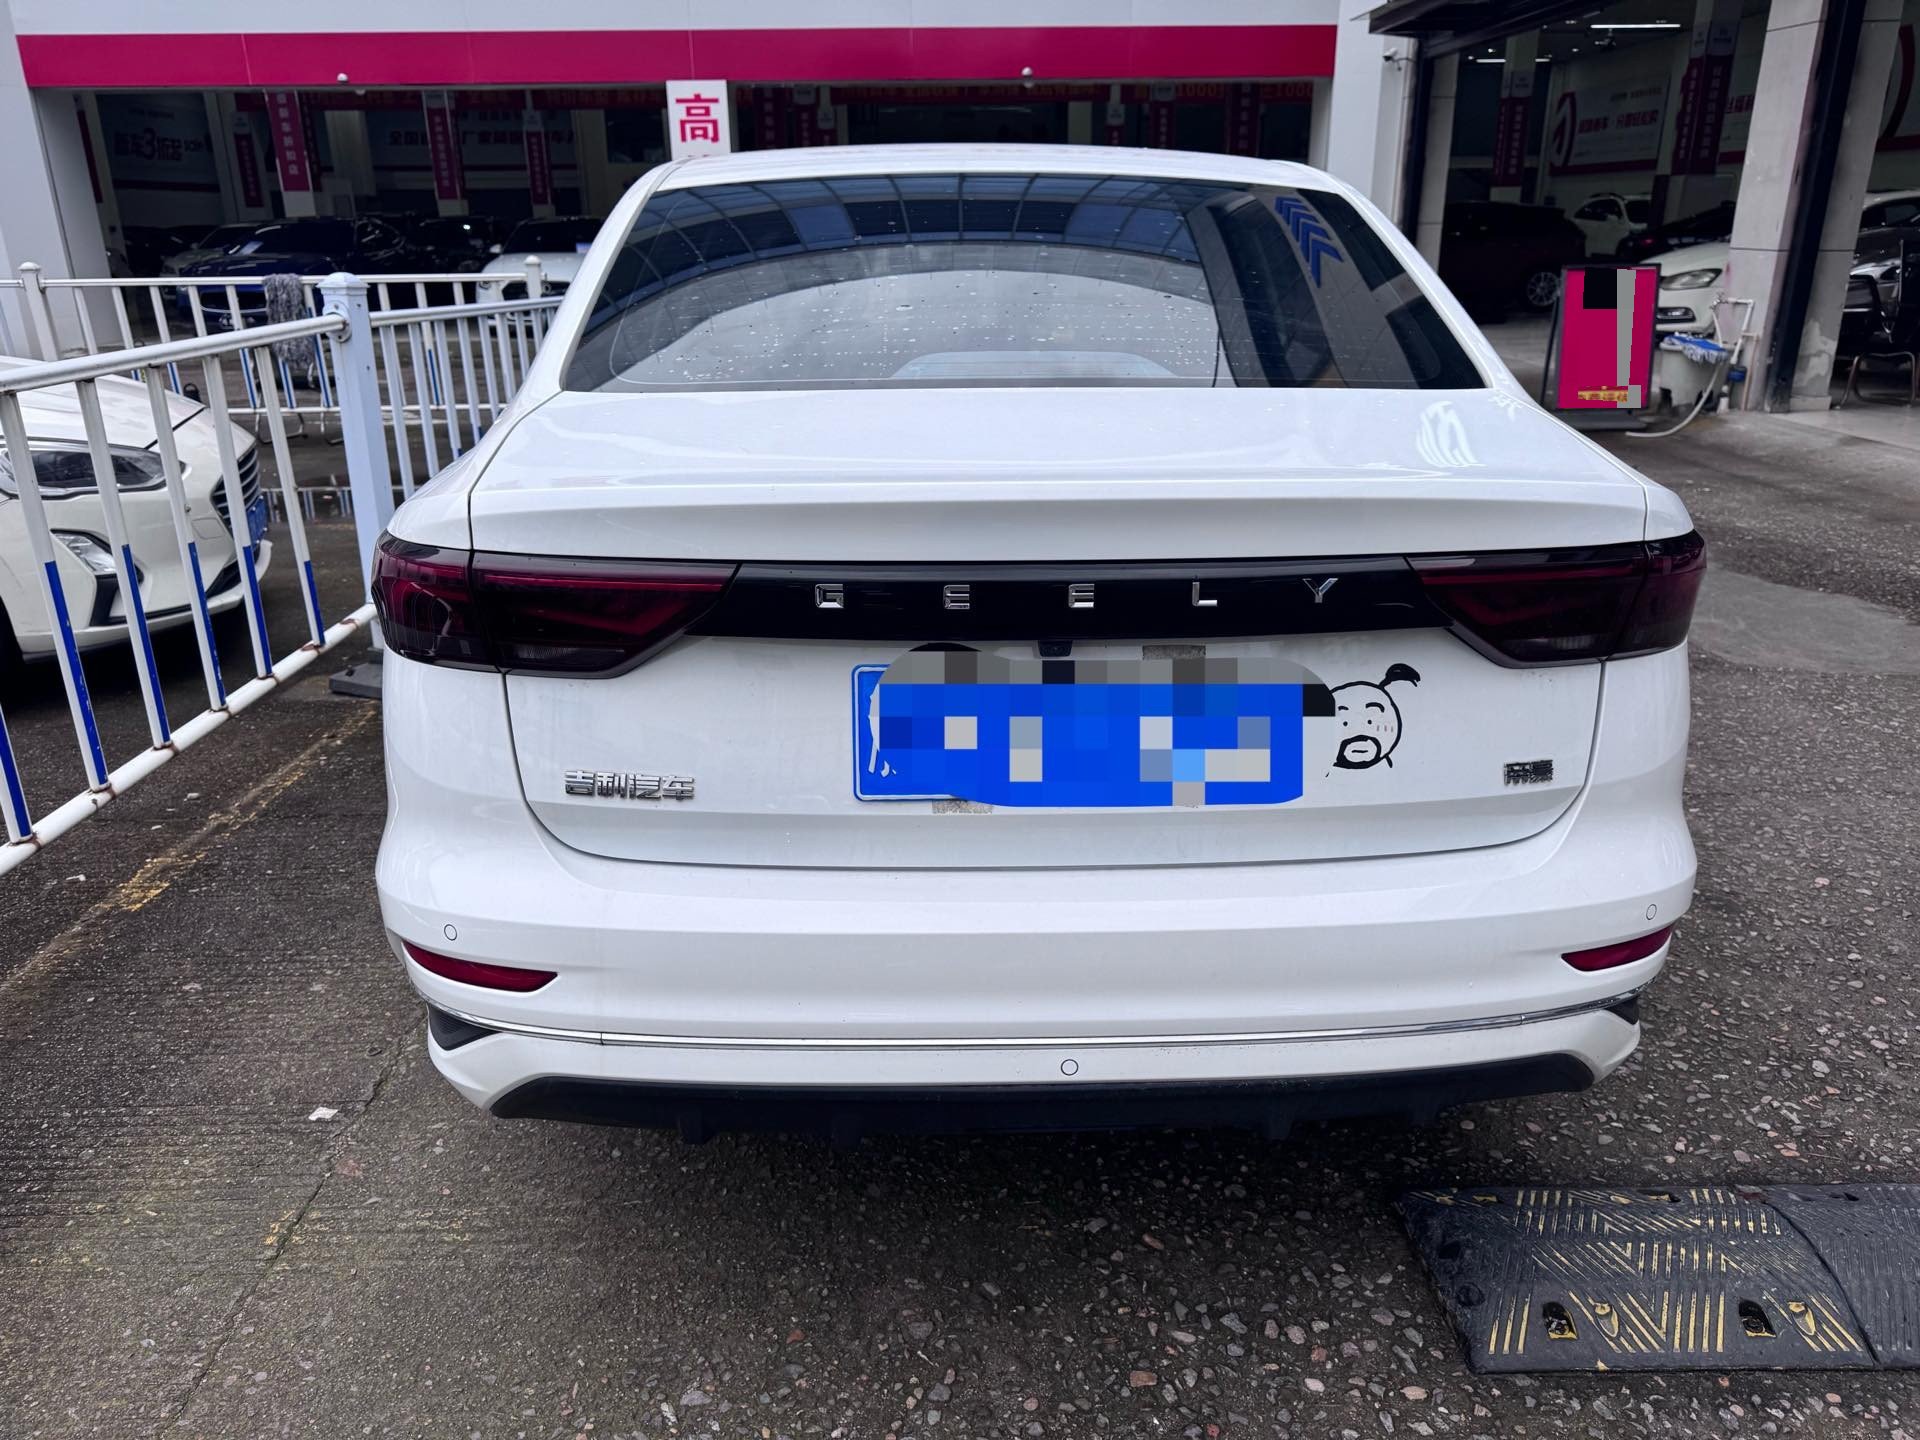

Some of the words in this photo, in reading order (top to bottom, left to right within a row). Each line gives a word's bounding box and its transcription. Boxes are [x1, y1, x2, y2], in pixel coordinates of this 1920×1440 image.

[675, 93, 720, 143] 高
[814, 577, 1339, 609] GEELY
[564, 769, 695, 801] 吉利汽车
